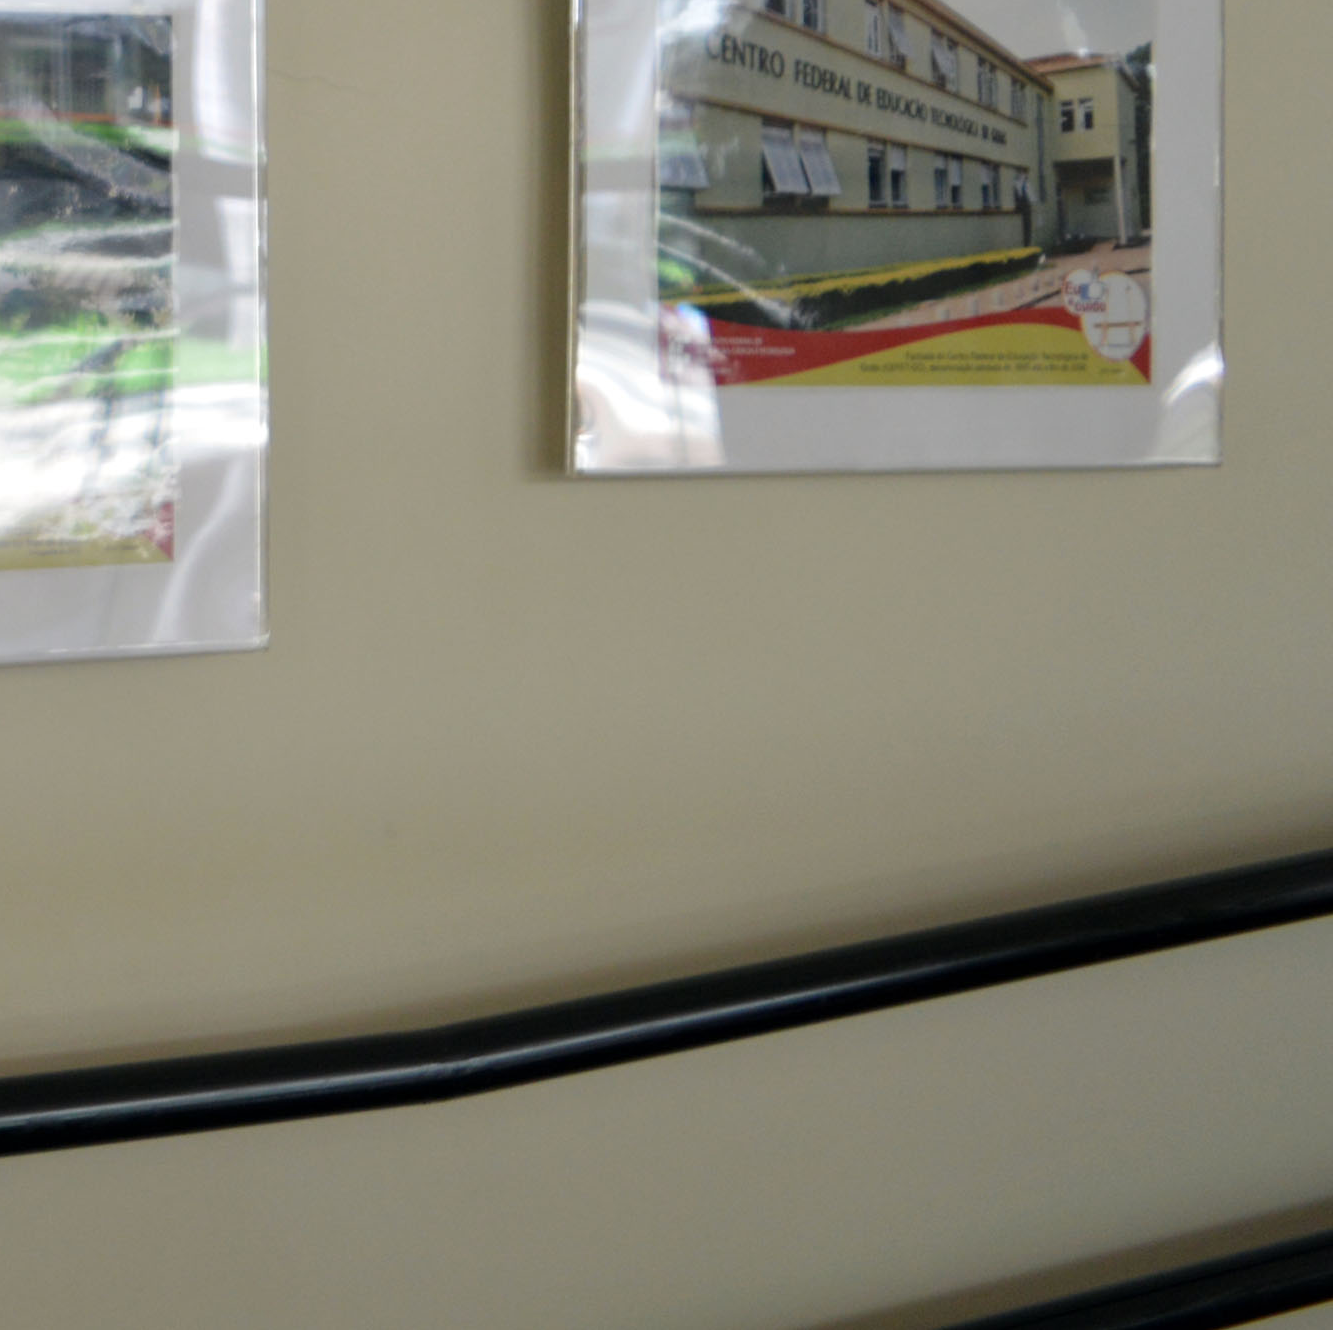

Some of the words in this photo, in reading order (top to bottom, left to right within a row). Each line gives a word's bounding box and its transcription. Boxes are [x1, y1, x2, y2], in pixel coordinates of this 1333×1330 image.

[706, 30, 785, 79] CENTRO
[794, 58, 852, 99] FEDERAL
[857, 79, 873, 104] DE
